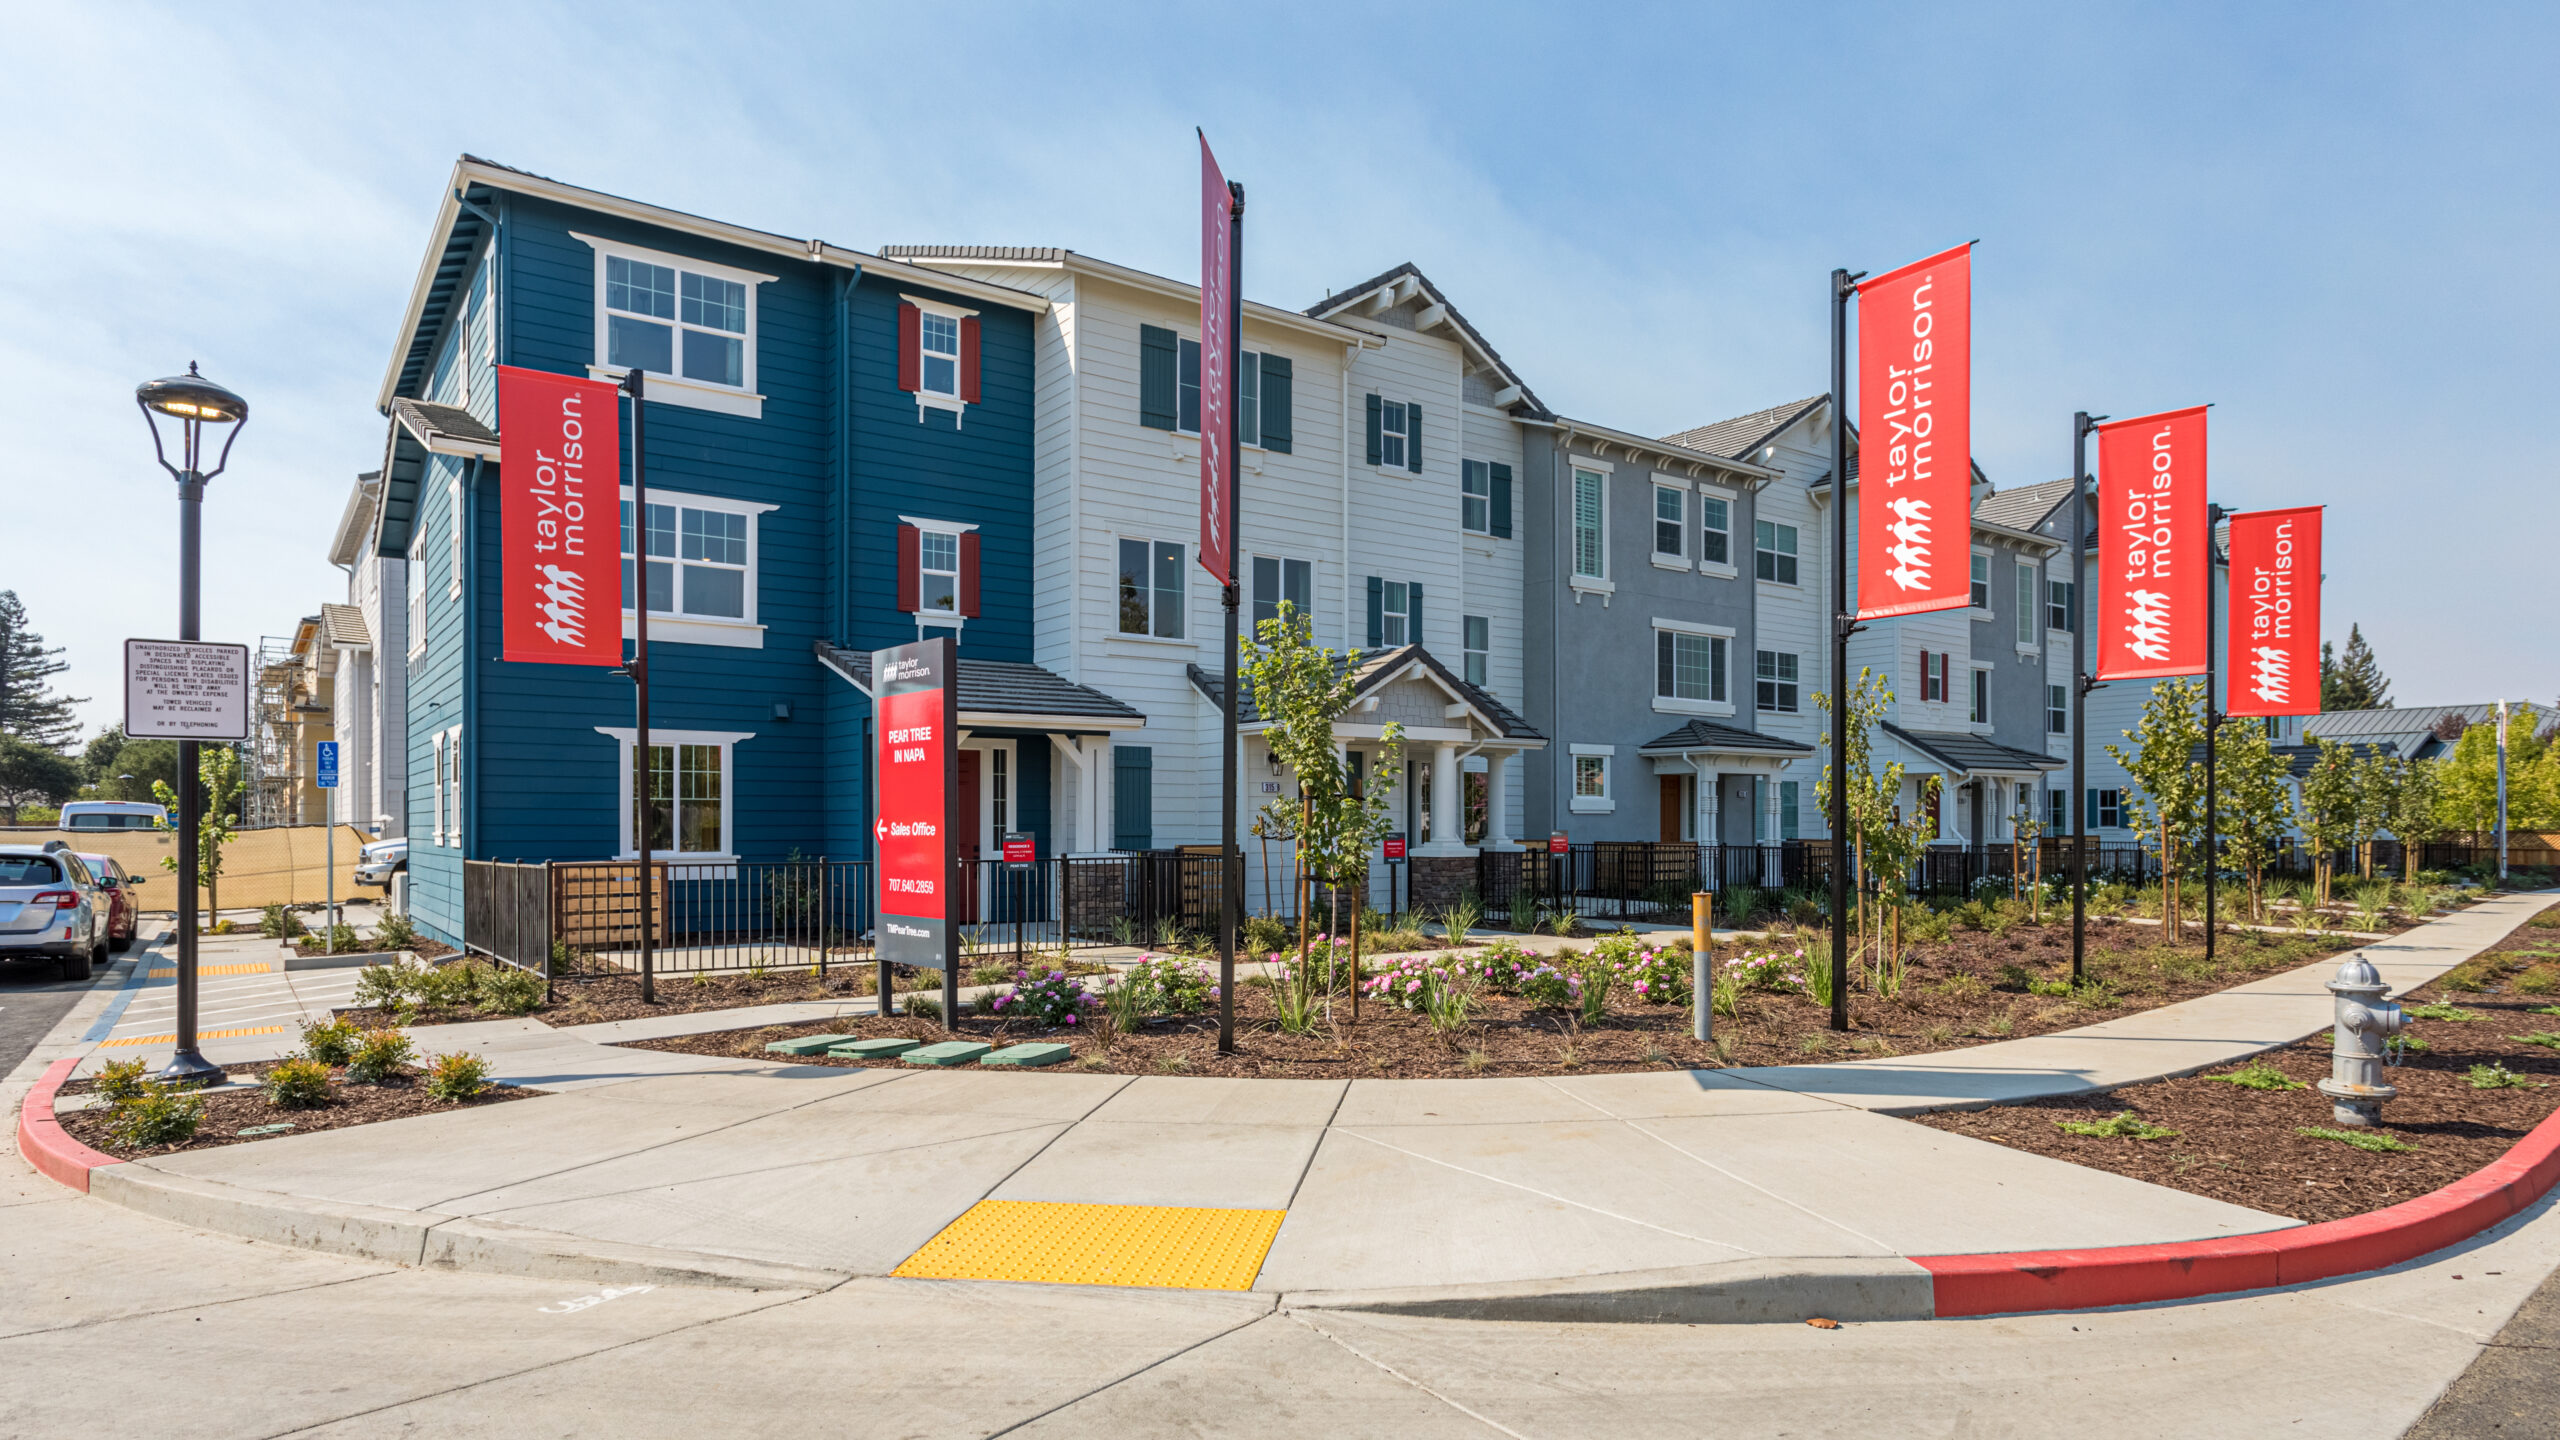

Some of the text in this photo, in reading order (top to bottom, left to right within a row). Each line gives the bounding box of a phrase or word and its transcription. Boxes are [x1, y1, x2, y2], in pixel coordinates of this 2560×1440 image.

[1207, 265, 1217, 414] taylor
[1883, 364, 1912, 488] taylor
[530, 449, 562, 553] taylor
[2122, 489, 2151, 582] taylor
[2249, 566, 2274, 640] taylor
[898, 658, 918, 671] taylor
[888, 726, 932, 744] PEAR TREE
[894, 748, 925, 763] IN NAPA
[890, 822, 936, 836] Sales Office
[888, 878, 934, 894] 707.640.2859
[886, 923, 930, 938] TMPearTree.com
